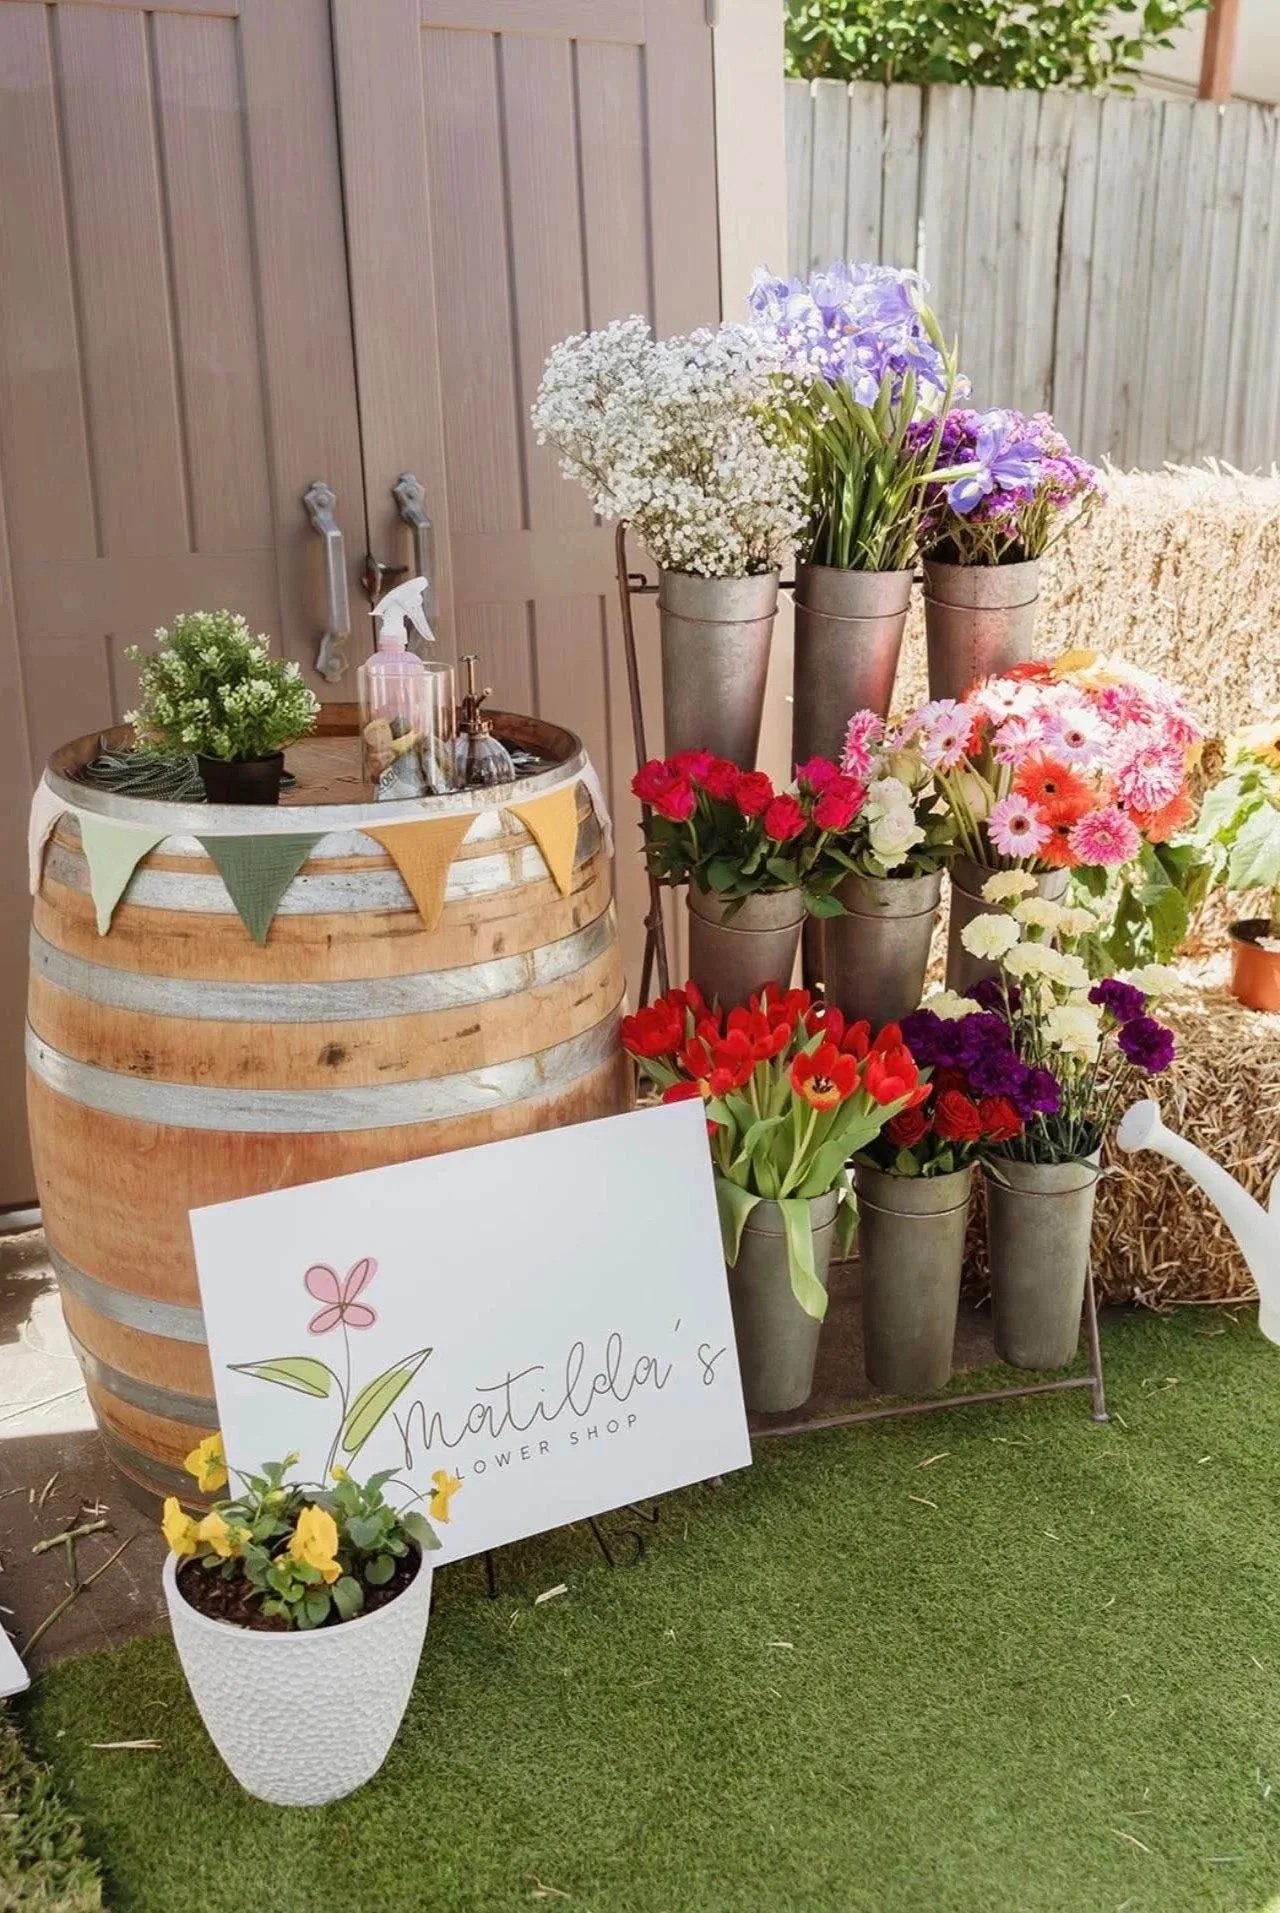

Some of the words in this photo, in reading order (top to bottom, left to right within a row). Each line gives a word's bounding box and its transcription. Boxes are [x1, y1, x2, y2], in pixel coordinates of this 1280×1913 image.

[392, 1318, 727, 1470] Matilda's
[455, 1440, 550, 1480] LOWER
[569, 1413, 637, 1446] SHOP
